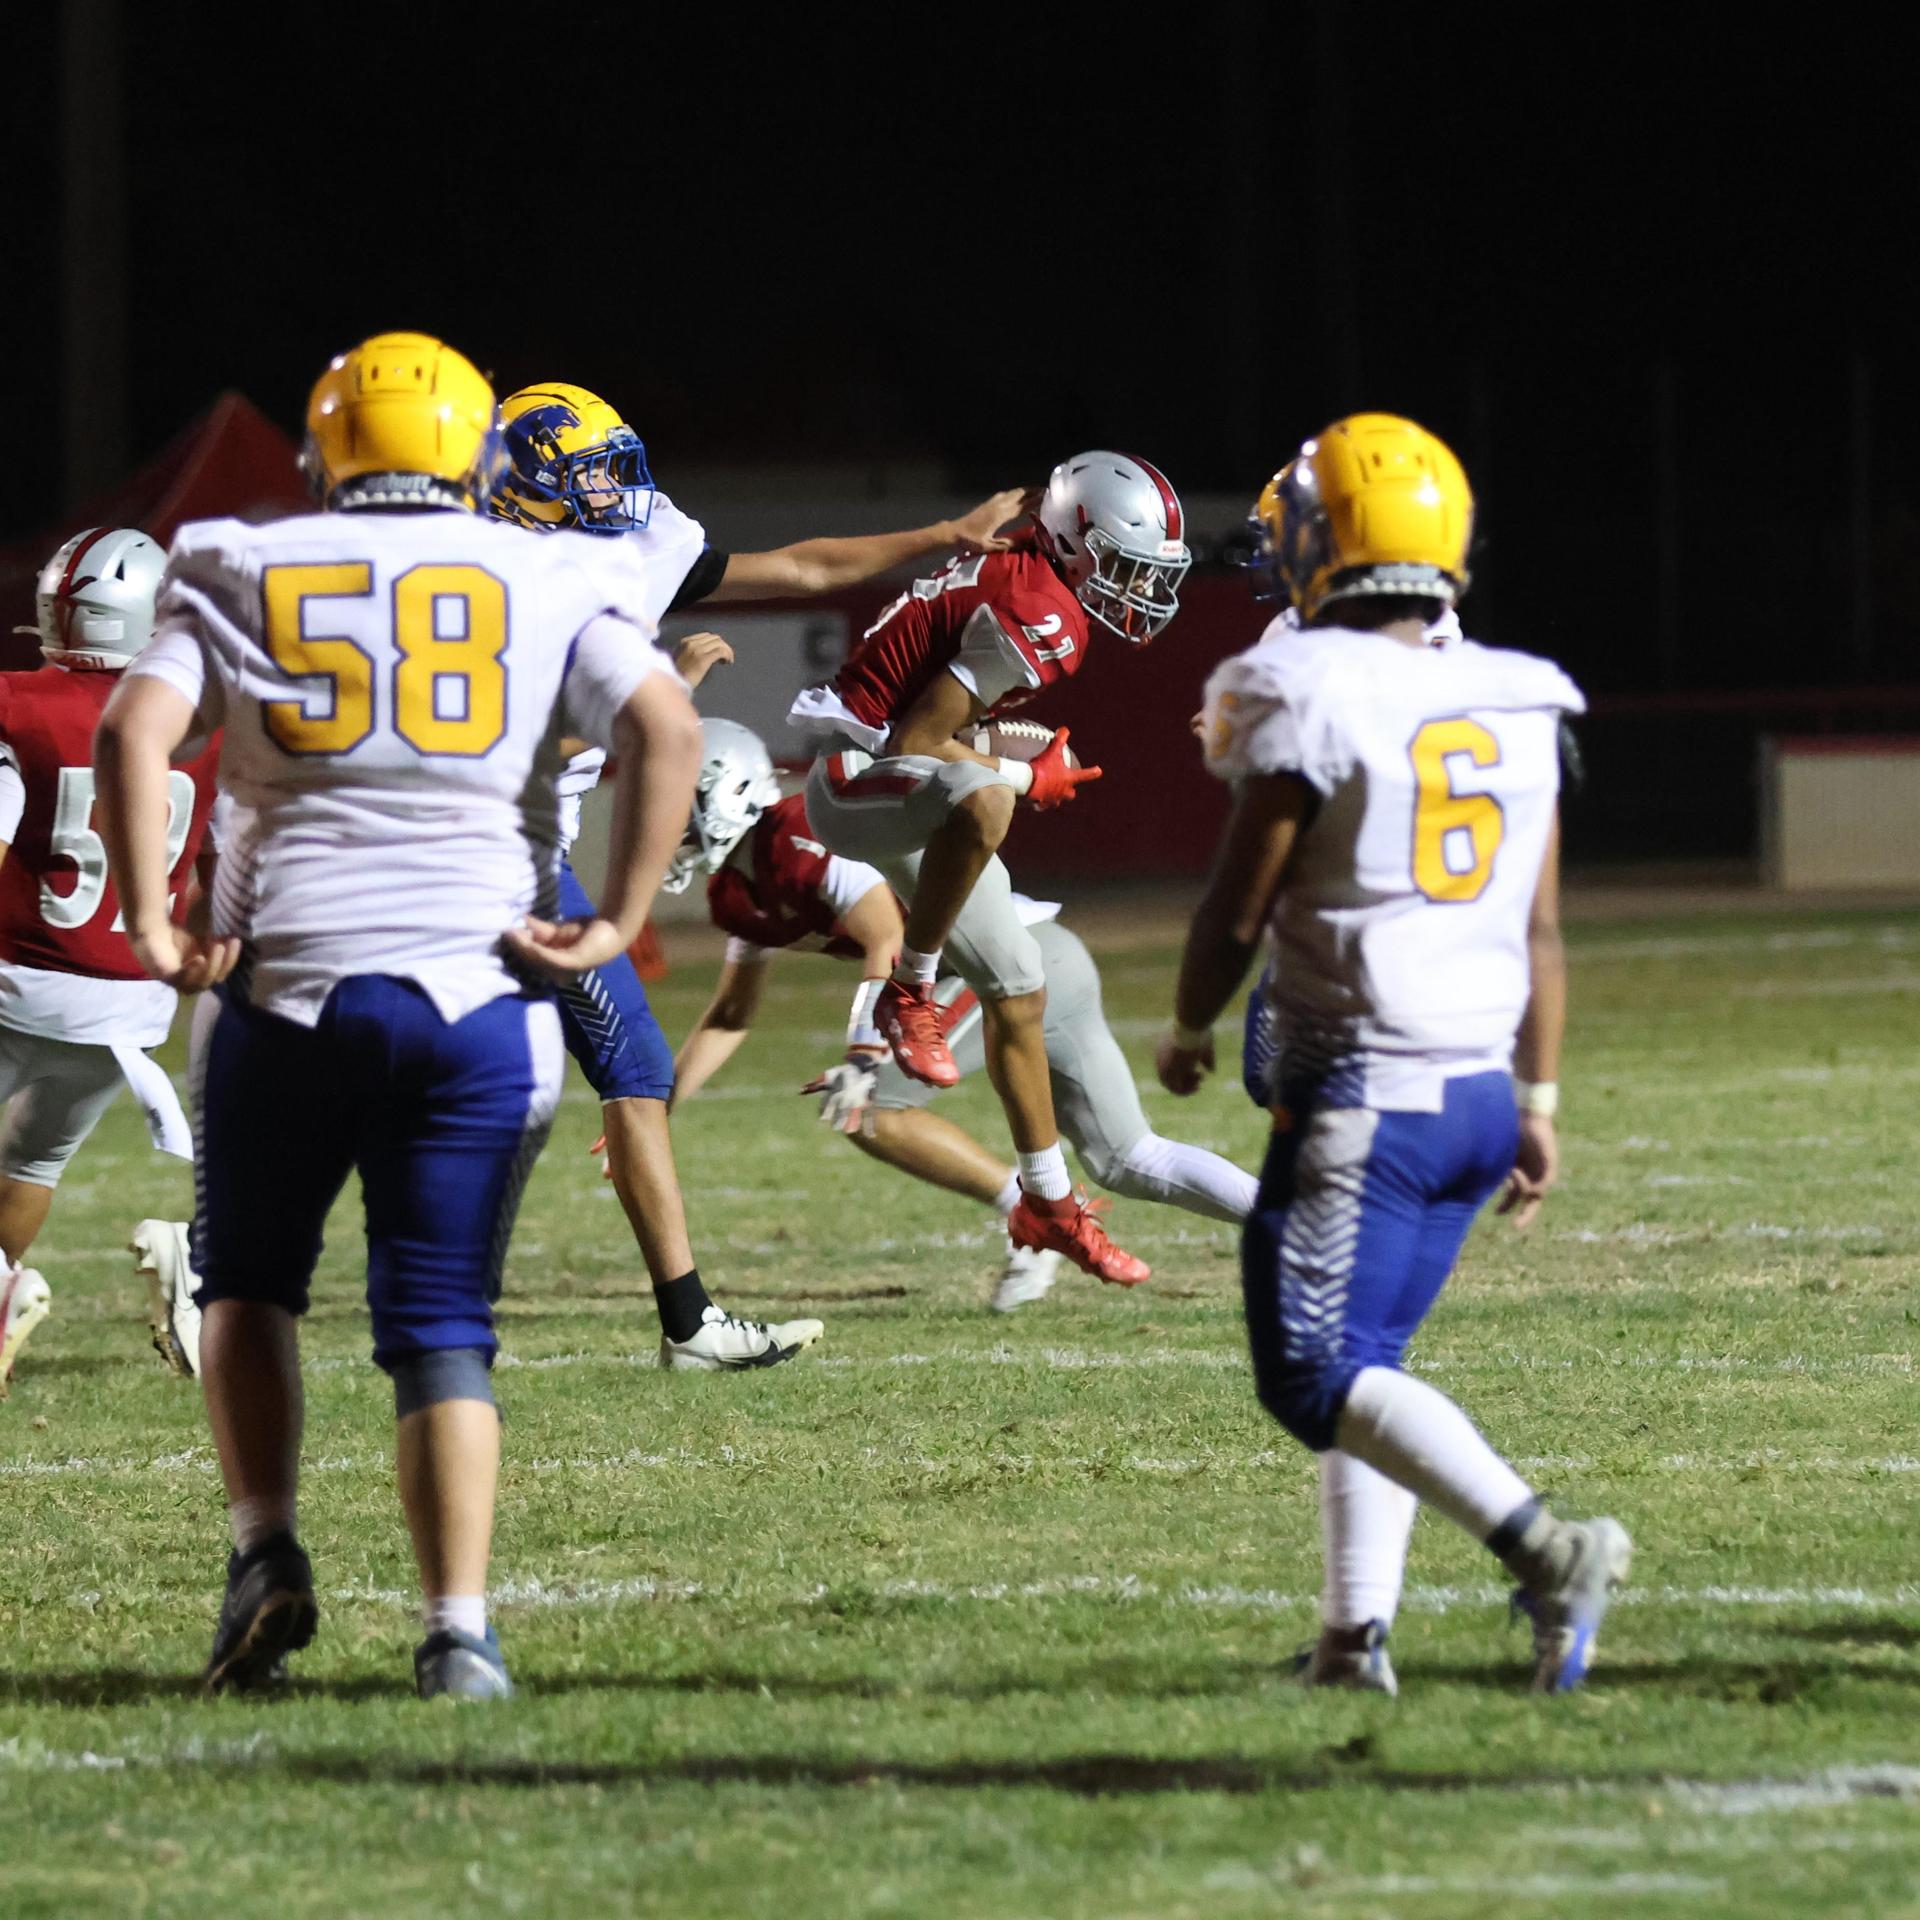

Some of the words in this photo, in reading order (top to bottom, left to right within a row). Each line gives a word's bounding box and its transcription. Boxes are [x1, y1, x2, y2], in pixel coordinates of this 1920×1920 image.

[262, 561, 511, 759] 58
[1021, 613, 1075, 664] 27
[1408, 713, 1504, 904] 6
